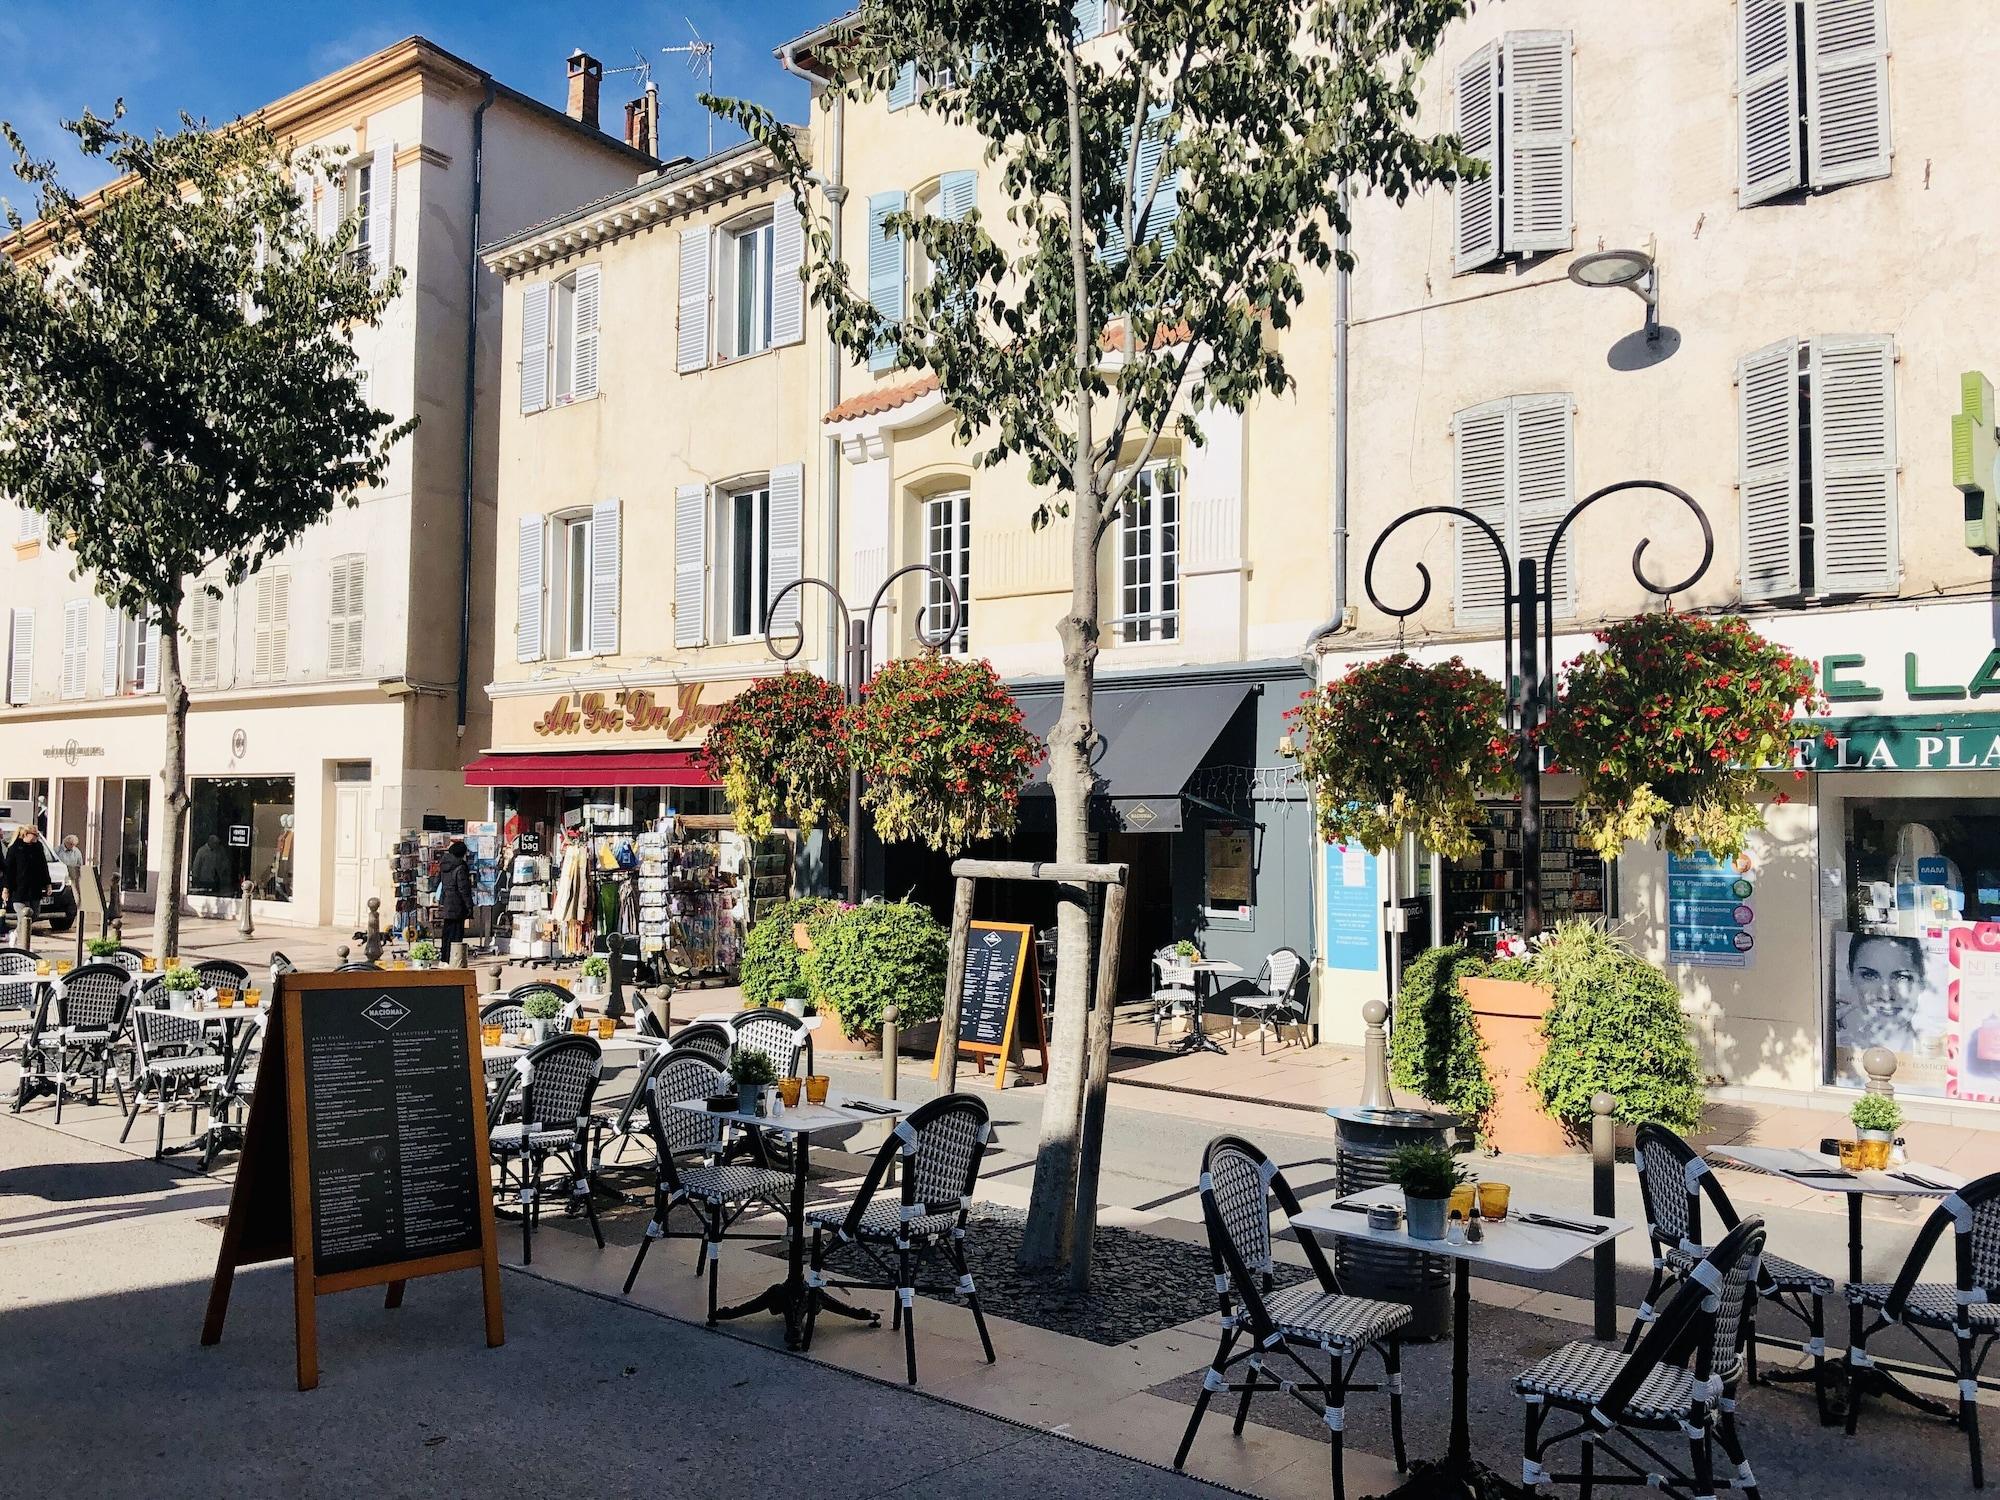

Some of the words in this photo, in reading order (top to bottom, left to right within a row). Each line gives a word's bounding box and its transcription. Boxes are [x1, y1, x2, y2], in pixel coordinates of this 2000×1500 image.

[534, 696, 580, 736] Au
[625, 689, 671, 731] Du
[1834, 737, 1898, 767] LA
[521, 842, 539, 852] bag
[1921, 866, 1945, 874] MAM
[369, 1008, 403, 1017] NACIONAL
